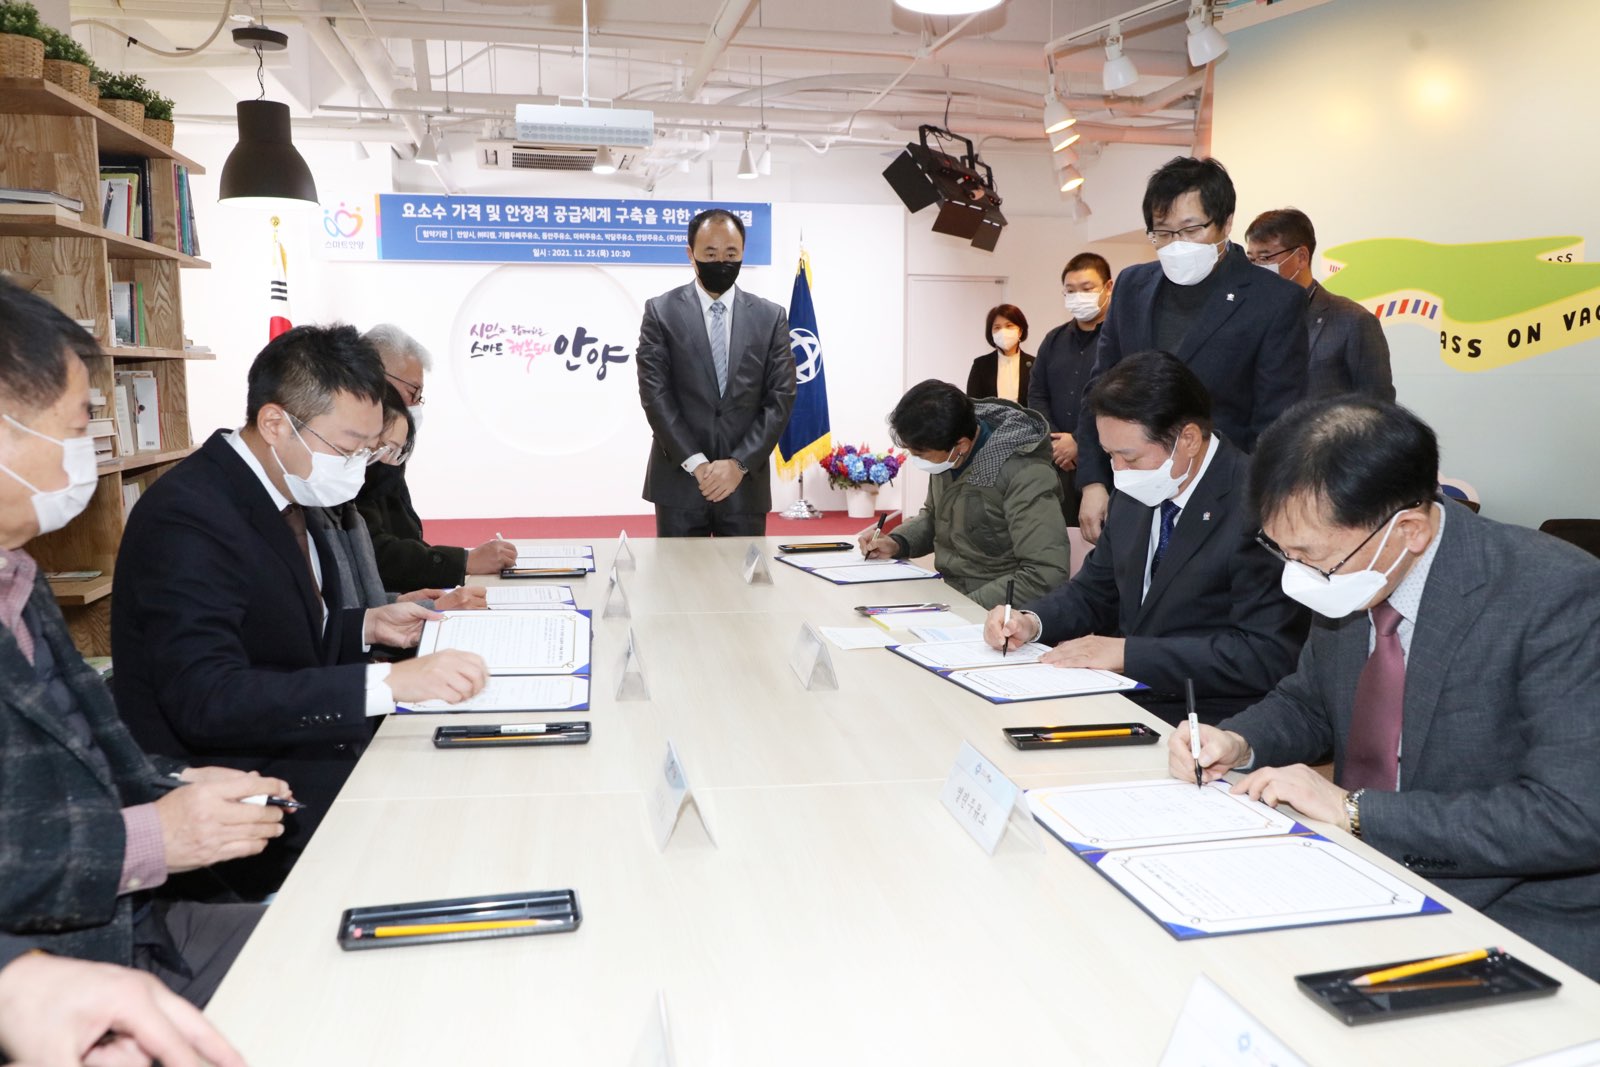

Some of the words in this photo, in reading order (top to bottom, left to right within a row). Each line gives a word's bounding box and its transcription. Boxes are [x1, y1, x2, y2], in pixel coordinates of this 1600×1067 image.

[402, 202, 447, 220] 요소수
[451, 203, 481, 221] 가격
[486, 204, 501, 222] 및
[504, 204, 548, 223] 안정적
[553, 205, 611, 223] 공급체계
[615, 206, 658, 225] 구축을
[662, 207, 690, 225] 위한
[730, 210, 753, 227] 결
[325, 240, 364, 250] 스마트안양
[532, 248, 547, 257] 일시
[552, 249, 572, 257] 2021.
[574, 249, 585, 257] 11.
[610, 250, 631, 258] 10:30
[1548, 253, 1573, 263] SS
[1507, 322, 1541, 349] ON
[470, 340, 503, 358] 스마트
[553, 326, 630, 381] 안양
